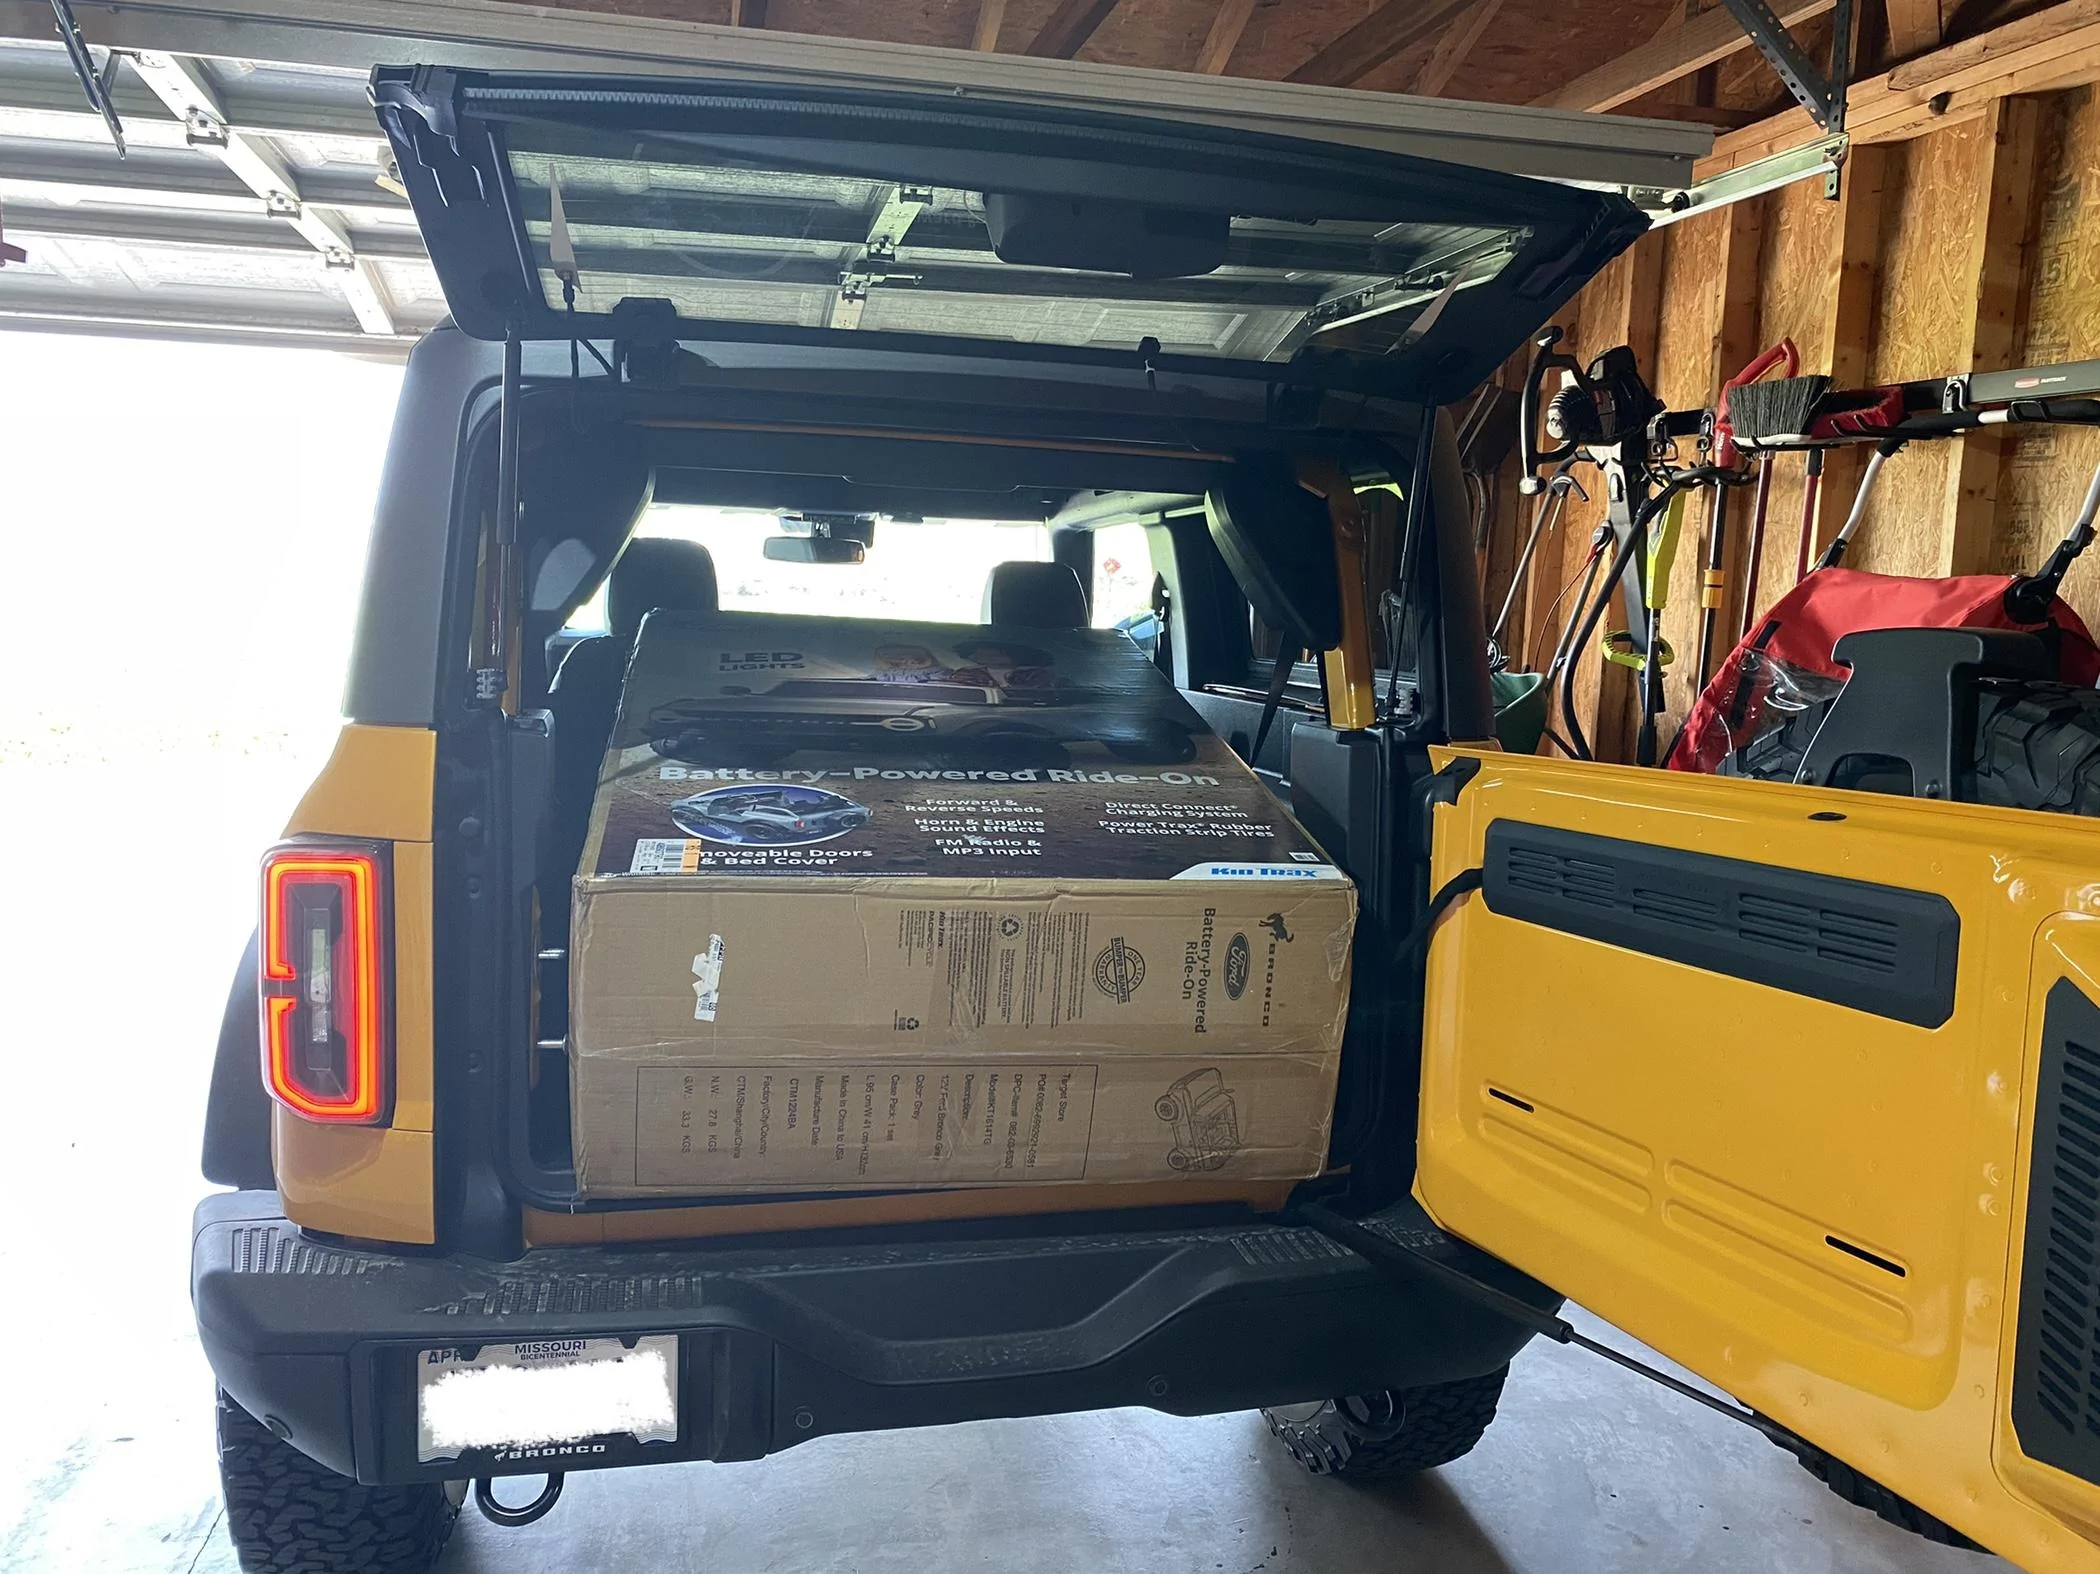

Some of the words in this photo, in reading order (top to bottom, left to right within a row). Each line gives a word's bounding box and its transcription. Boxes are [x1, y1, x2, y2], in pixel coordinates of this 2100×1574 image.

[719, 652, 803, 663] LED
[719, 663, 805, 671] LIGHTS
[659, 766, 1038, 783] Battery-Powered
[1047, 769, 1220, 786] Ride-On
[905, 805, 977, 813] Reverse
[981, 806, 1044, 814] Speeds
[1105, 801, 1156, 809] Direct
[1105, 808, 1182, 818] Charging
[1186, 810, 1248, 818] System
[914, 818, 960, 826] Horn
[966, 818, 979, 826] &
[984, 819, 1045, 828] Engine
[1098, 820, 1155, 828] Power
[1209, 823, 1272, 831] Rubber
[1105, 827, 1181, 835] Traction
[1186, 828, 1227, 837] Strip
[935, 838, 963, 846] FM
[968, 838, 1022, 847] Radio
[1027, 839, 1042, 847] &
[700, 857, 717, 865] &
[723, 856, 766, 865] Bed
[773, 857, 838, 866] Cover
[809, 848, 873, 858] Doors
[942, 847, 984, 855] MP3
[989, 848, 1042, 857] Input
[1128, 951, 1141, 965] ONE
[1228, 946, 1247, 986] Ford
[1099, 953, 1116, 991] WARRANTY
[1113, 937, 1123, 967] BUMPER
[1118, 974, 1127, 1003] BUMPER
[1131, 966, 1142, 986] YEAR
[1182, 941, 1198, 1000] Ride-On
[1195, 907, 1217, 1034] Battery-Powered
[1262, 943, 1275, 1027] BRONCO
[839, 1074, 850, 1098] Made
[865, 1081, 875, 1093] 95
[889, 1074, 900, 1096] Case
[1059, 1073, 1072, 1099] Target
[812, 1075, 825, 1126] Manufacture
[732, 1075, 747, 1159] CTM/Shanghai/China
[911, 1100, 923, 1120] Grey
[1057, 1100, 1068, 1122] Store
[837, 1108, 848, 1133] China
[862, 1119, 872, 1129] 41
[935, 1112, 947, 1141] Bronco
[680, 1135, 692, 1153] KGS
[707, 1134, 718, 1153] KGS
[837, 1134, 845, 1143] to
[834, 1143, 845, 1161] USA
[514, 1340, 587, 1355] MISSOURI
[520, 1350, 581, 1361] BICENTENNIAL
[508, 1444, 606, 1460] BRONCO
